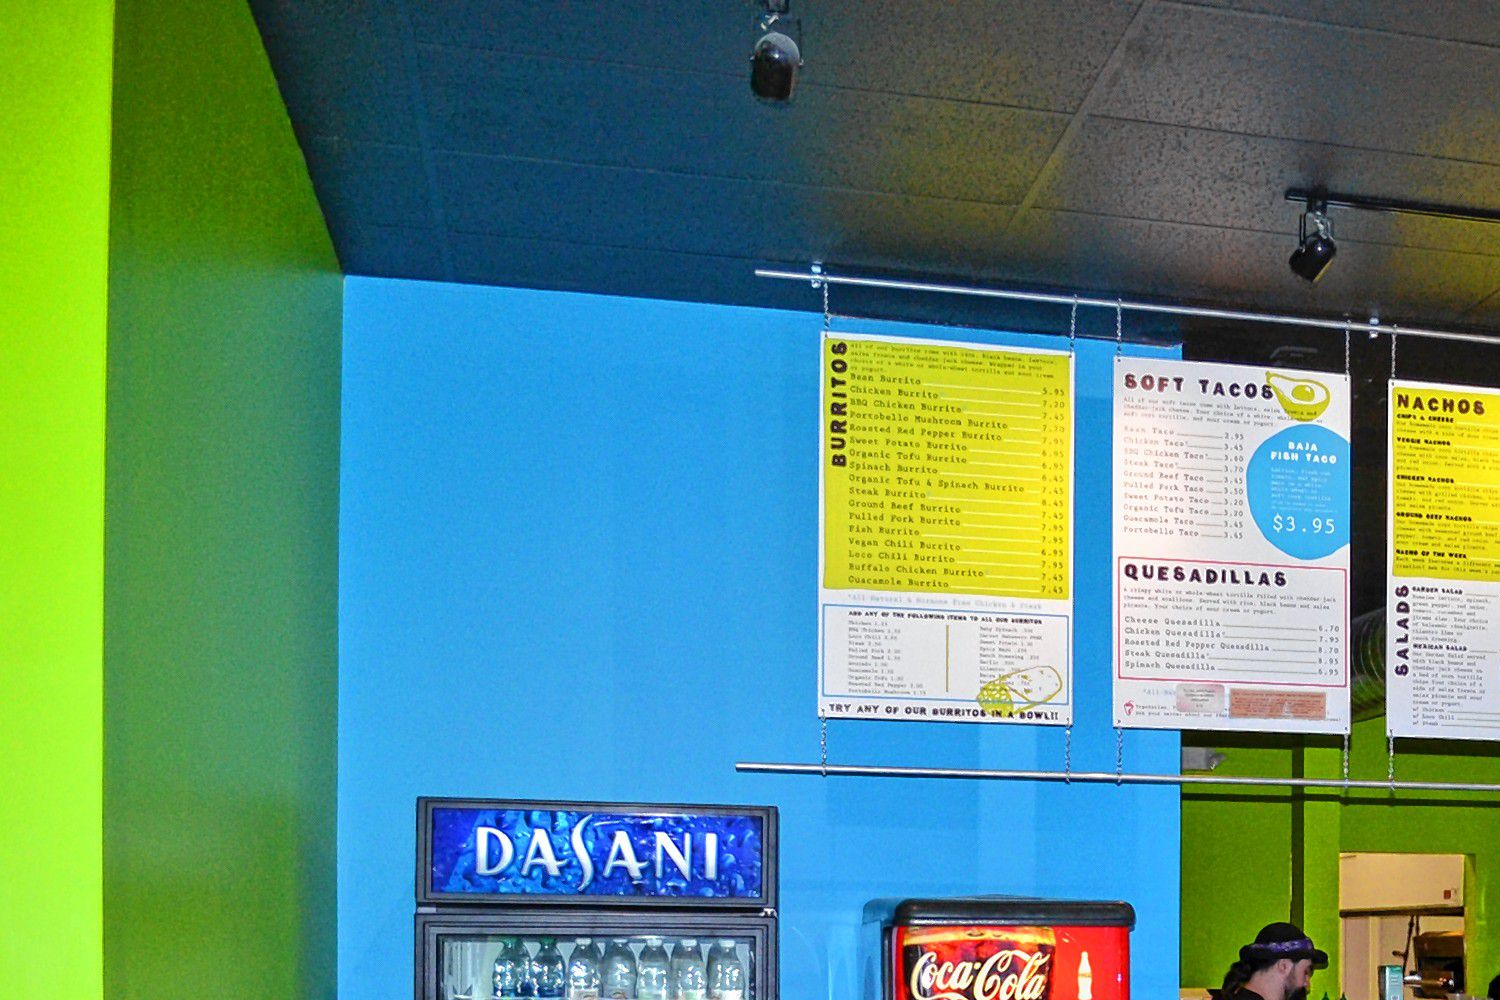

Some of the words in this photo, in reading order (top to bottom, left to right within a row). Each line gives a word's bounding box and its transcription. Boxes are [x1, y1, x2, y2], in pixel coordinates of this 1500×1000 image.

[850, 385, 891, 395] Chicken
[897, 389, 938, 398] Burrito
[1125, 373, 1183, 393] SOFT
[1198, 379, 1273, 400] TACOS
[830, 341, 847, 467] BURRITOS
[1397, 393, 1484, 416] NACHOS
[850, 411, 909, 422] Portobello
[915, 415, 961, 425] Mushroom
[967, 419, 1007, 428] Burrito
[849, 423, 891, 433] Roasted
[897, 427, 914, 435] Red
[920, 428, 955, 439] Pepper
[961, 431, 1001, 440] Burrito
[1288, 441, 1317, 451] BAJA
[1424, 438, 1450, 446] NACHOS
[849, 448, 891, 459] Organic
[897, 451, 920, 460] Tofu
[926, 453, 966, 463] Burrito
[1270, 451, 1298, 461] FISH
[1306, 453, 1336, 464] TACO
[849, 461, 890, 472] Spinach
[896, 464, 937, 474] Burrito
[849, 474, 890, 485] Organic
[896, 477, 920, 486] Tofu
[937, 480, 978, 490] Spinach
[984, 483, 1024, 492] Burrito
[1428, 476, 1454, 484] NACHOS
[849, 486, 878, 495] Steak
[884, 488, 925, 498] Burrito
[849, 499, 884, 508] Ground
[890, 501, 914, 510] Beef
[920, 503, 960, 512] Burrito
[849, 512, 884, 521] Pulled
[890, 514, 913, 523] Pork
[919, 516, 960, 525] Burrito
[1272, 513, 1335, 536] $3.95
[1445, 514, 1471, 522] NACHOS
[849, 525, 872, 533] Fish
[878, 526, 919, 536] Burrito
[848, 538, 878, 548] Vegan
[884, 540, 913, 548] Chili
[919, 541, 960, 550] Burrito
[848, 550, 872, 558] Loco
[878, 552, 907, 560] Chili
[913, 554, 954, 563] Burrito
[848, 563, 890, 572] Buffalo
[896, 565, 936, 574] Chicken
[942, 567, 983, 576] Burrito
[1124, 563, 1286, 587] QUESADILLAS
[848, 576, 901, 585] Guacamole
[907, 578, 948, 587] Burrito
[1395, 584, 1409, 676] SALADS
[829, 704, 850, 713] TRY
[857, 704, 878, 714] ANY
[885, 705, 898, 715] OF
[905, 706, 926, 716] OUR
[932, 707, 986, 718] BURRITOS
[991, 709, 1002, 718] IN
[475, 814, 718, 891] DASANI
